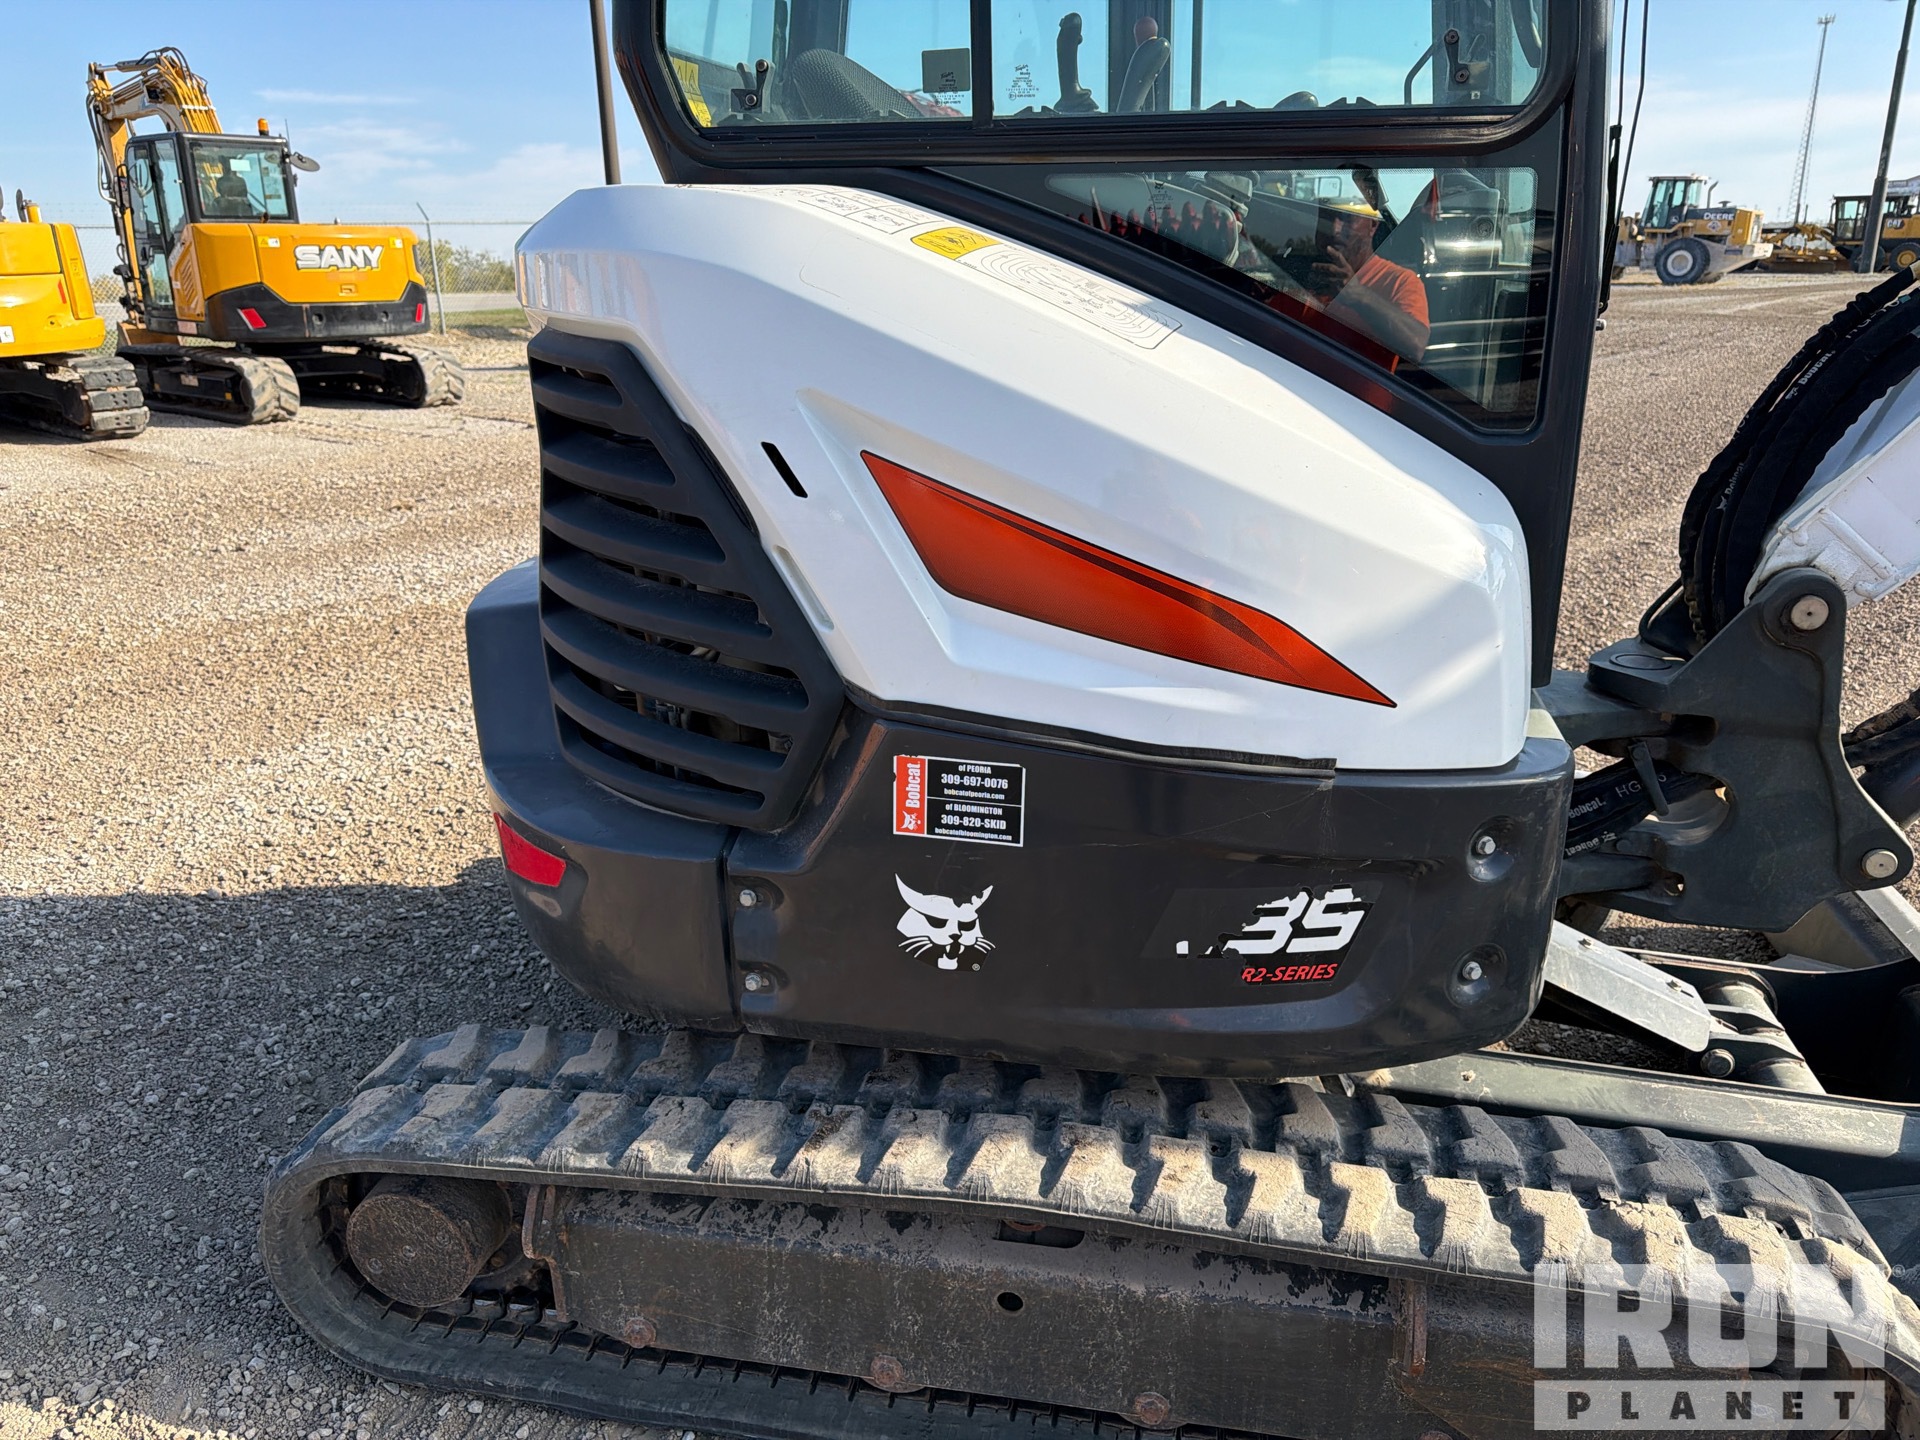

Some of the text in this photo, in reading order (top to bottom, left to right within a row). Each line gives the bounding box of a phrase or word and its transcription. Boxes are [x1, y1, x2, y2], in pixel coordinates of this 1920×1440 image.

[1703, 212, 1735, 220] DEERE
[1887, 220, 1901, 228] CAT
[295, 245, 383, 270] SANY
[958, 764, 992, 775] of PEORIA
[905, 762, 921, 808] Bobcat
[941, 773, 1009, 790] 309-697-0076
[944, 788, 1005, 800] bobcatofpeoria.com
[945, 803, 1003, 815] of BLOOMINGTON
[941, 814, 1007, 830] 309-820-SKID
[934, 827, 1012, 841] bobcatofbloomington.com
[1241, 963, 1339, 983] R2-SERIES
